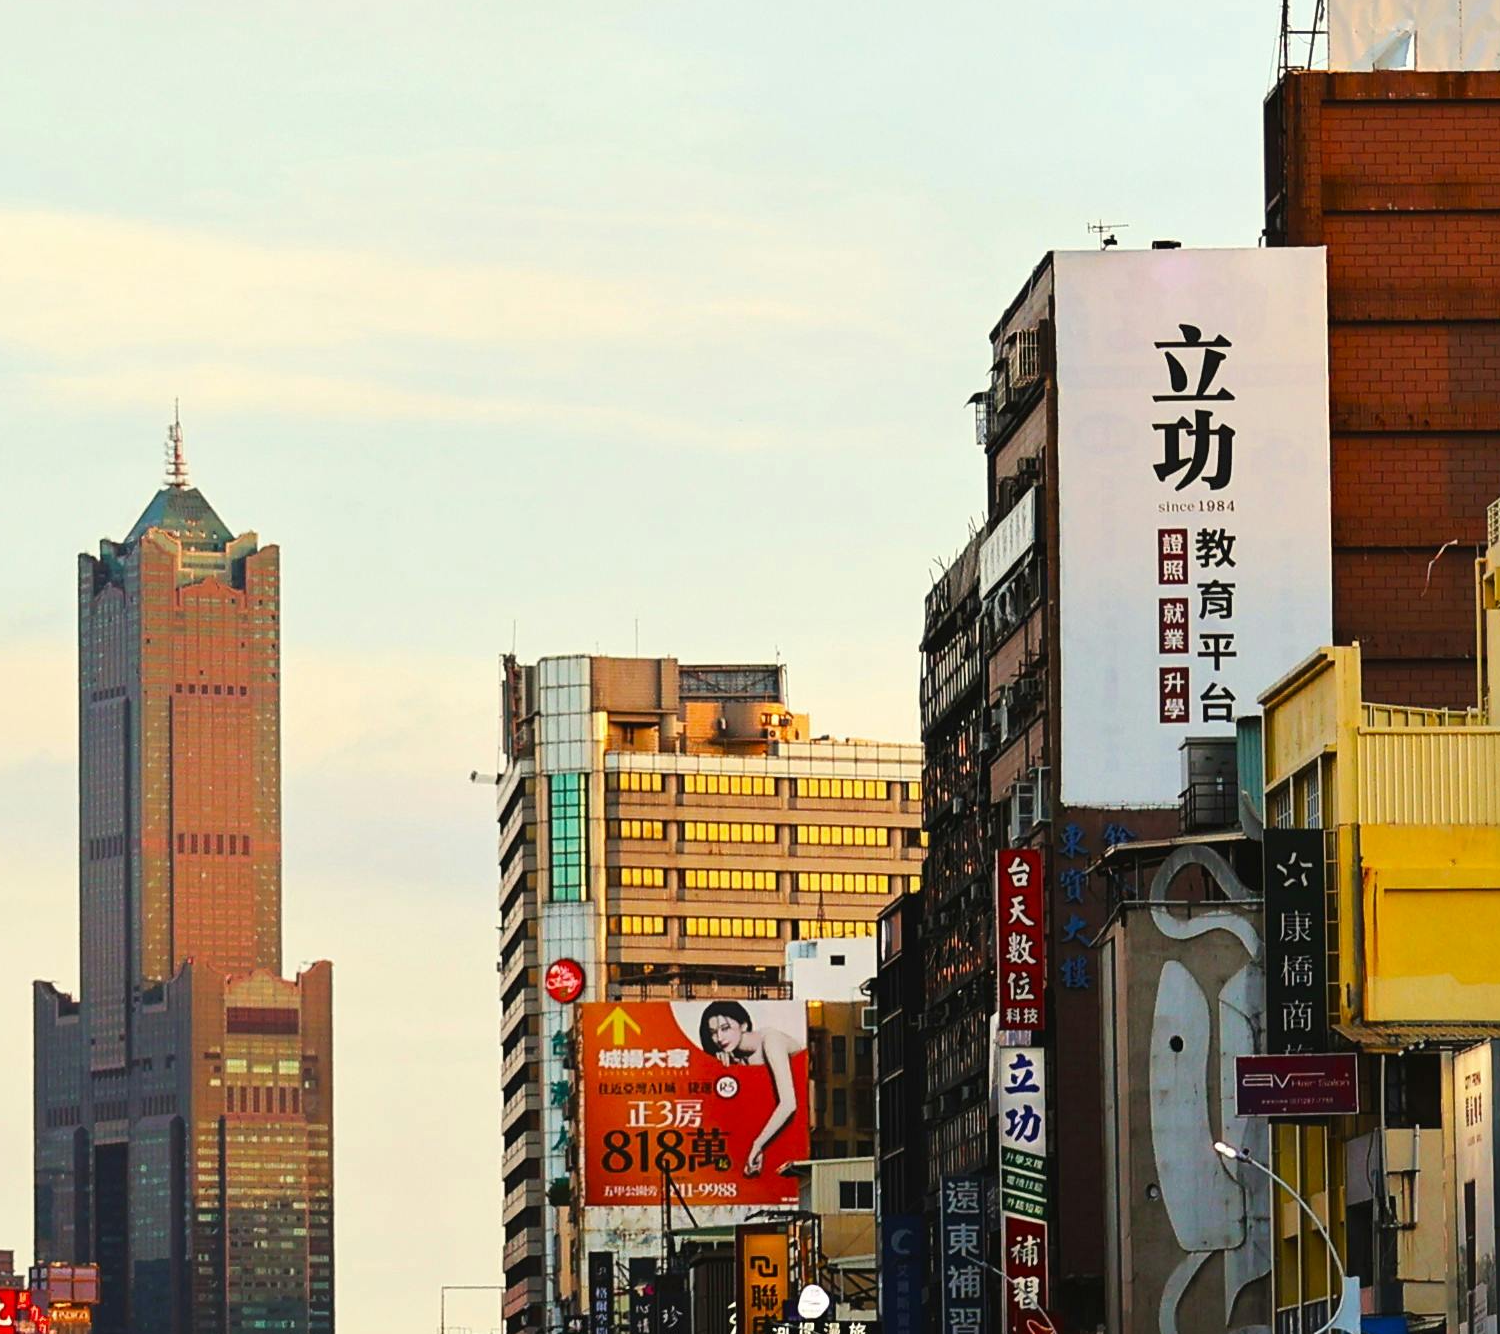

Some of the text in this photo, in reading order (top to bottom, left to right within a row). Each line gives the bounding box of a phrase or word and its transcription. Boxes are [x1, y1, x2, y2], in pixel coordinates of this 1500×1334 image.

[1152, 323, 1236, 492] 立功
[1158, 499, 1235, 512] since 1984
[1162, 532, 1185, 580] 證照
[1163, 601, 1185, 650] 就業
[1195, 528, 1237, 724] 教育平台
[1163, 670, 1185, 720] 升學
[1006, 856, 1038, 1002] 台天數位
[1279, 910, 1313, 1054] 康橋商
[1006, 1007, 1039, 1024] 科技
[625, 1098, 704, 1128] 正3房
[1004, 1052, 1041, 1144] 立功
[601, 1127, 731, 1174] 818萬
[1010, 1234, 1042, 1311] 補習
